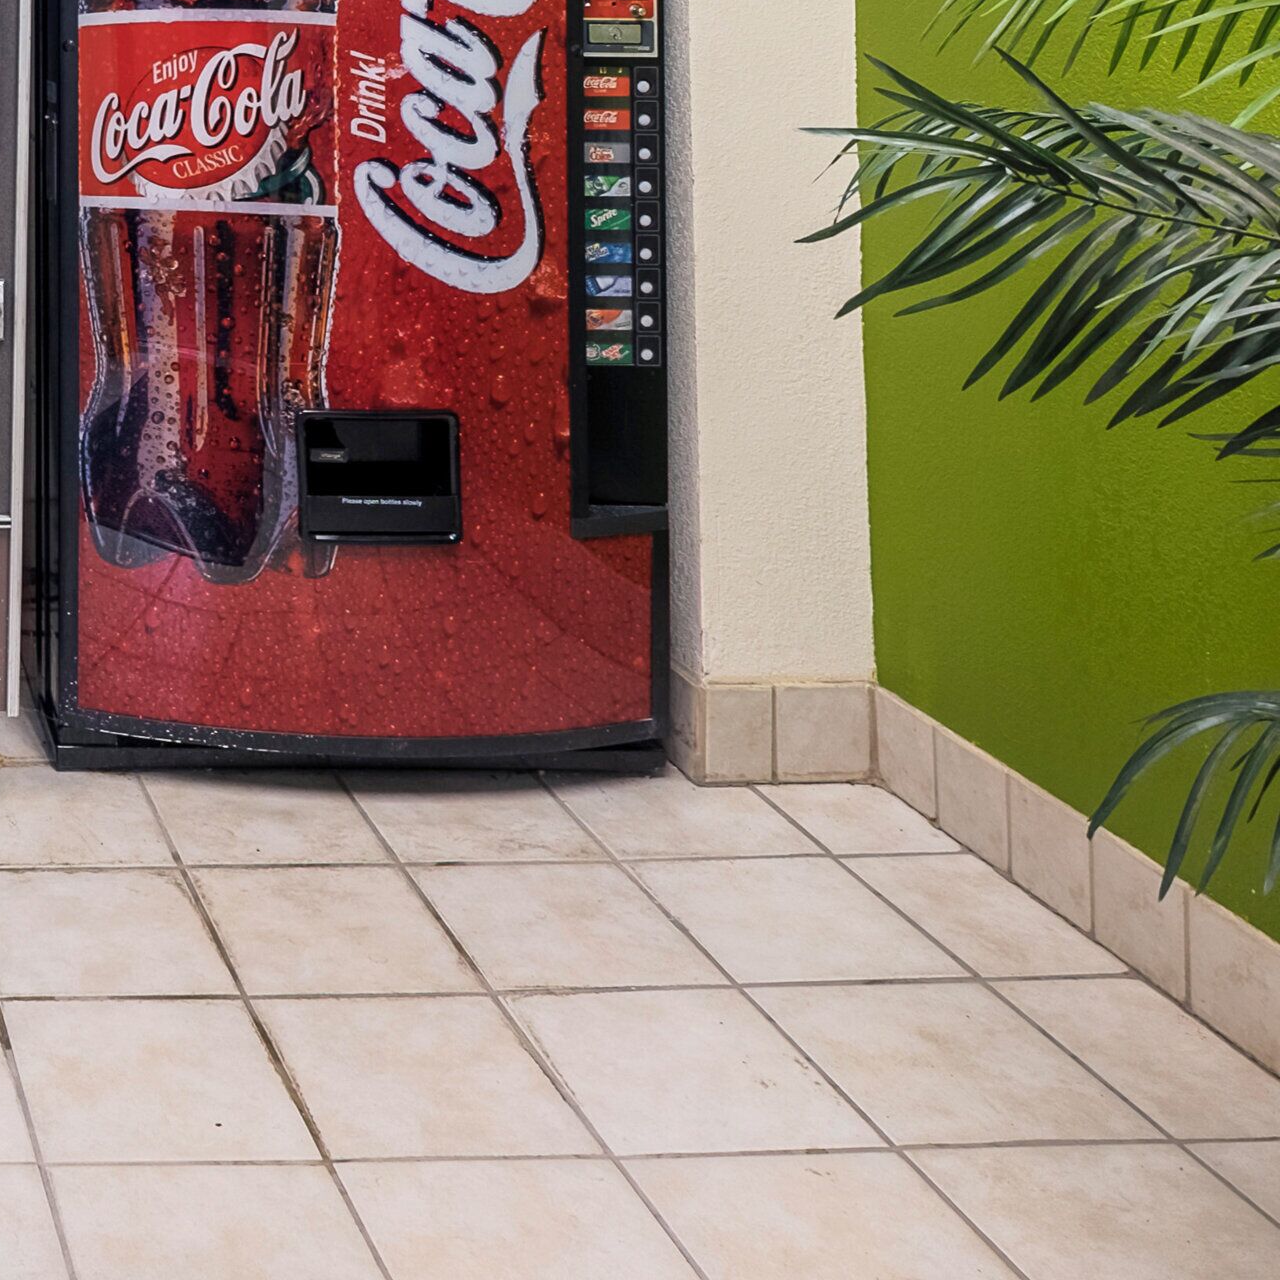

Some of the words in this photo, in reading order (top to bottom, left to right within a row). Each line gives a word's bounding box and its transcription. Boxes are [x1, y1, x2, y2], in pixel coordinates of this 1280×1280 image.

[151, 49, 199, 85] Enjoy
[583, 76, 618, 88] Coca-Cola
[90, 26, 309, 184] Coca-Cola
[350, 49, 387, 145] Drink!
[583, 110, 618, 123] Coca-Cola
[171, 144, 245, 180] CLASSIC
[590, 208, 618, 228] Sprite
[341, 497, 363, 505] Please
[402, 499, 423, 507] slowly
